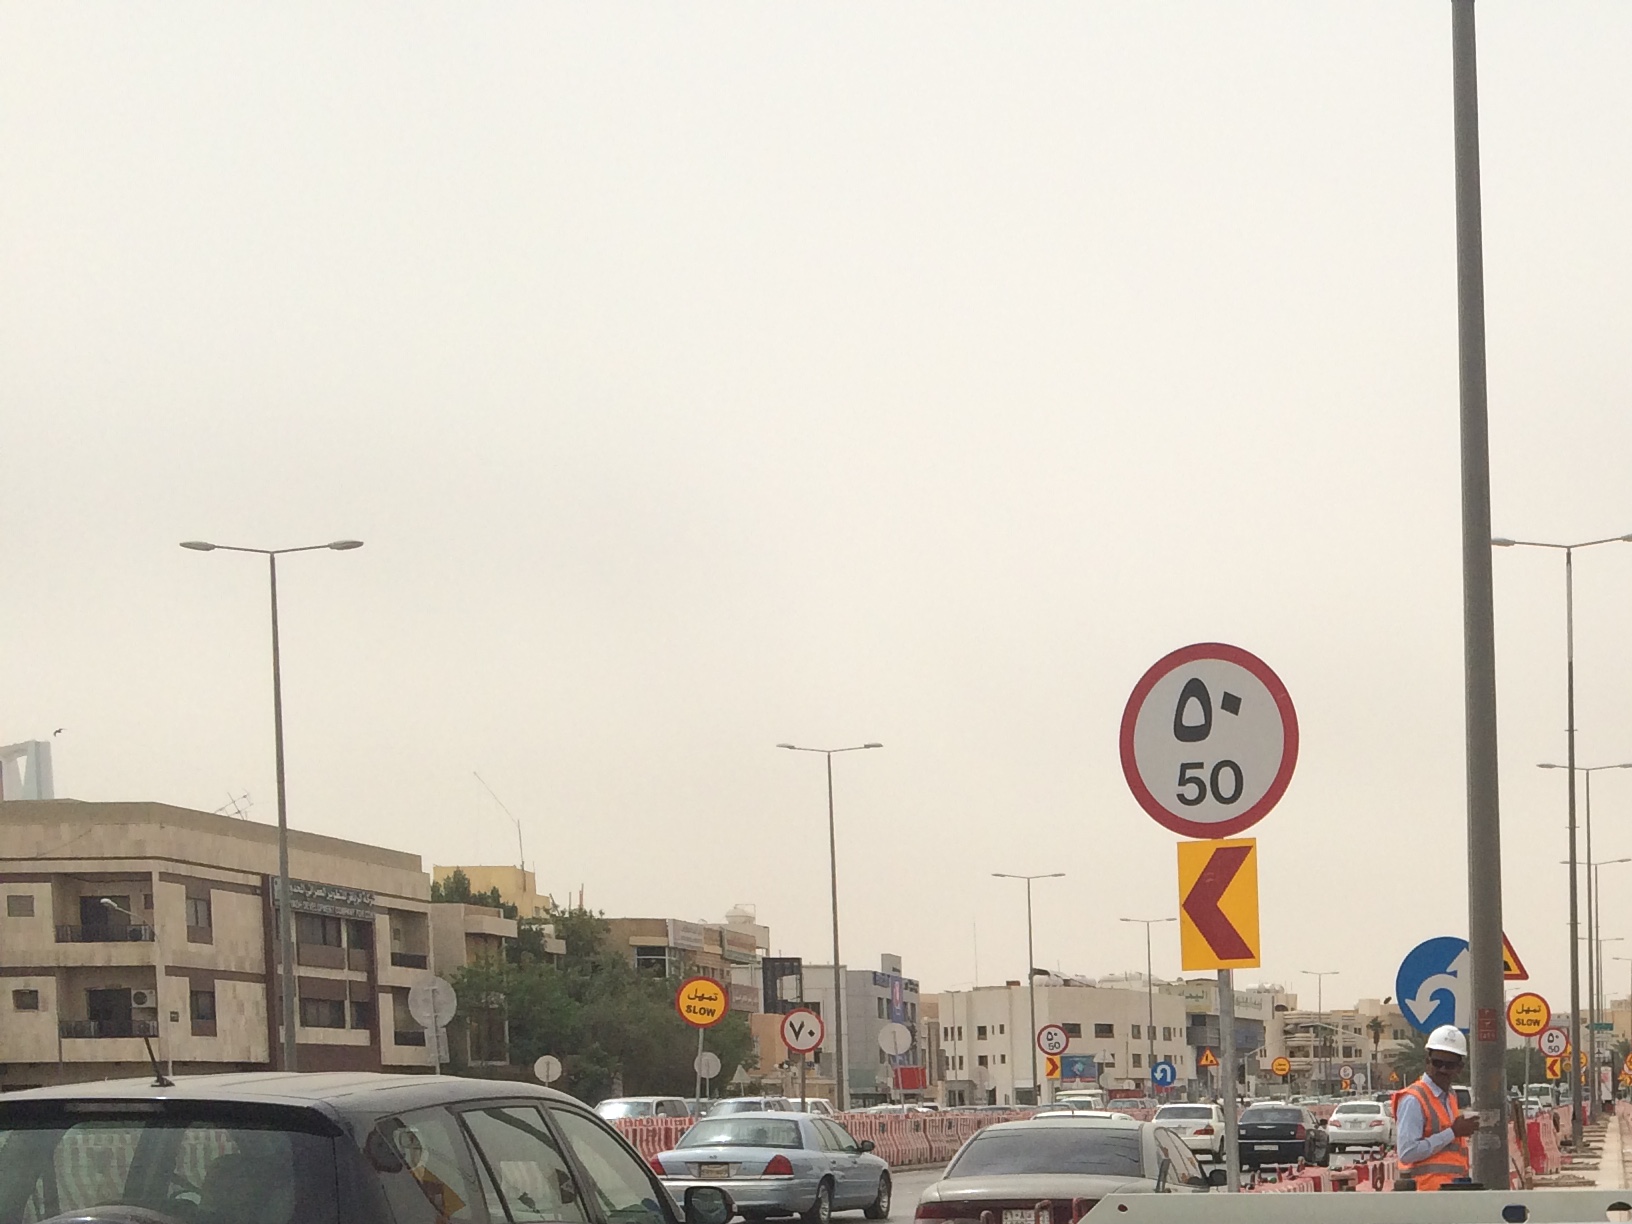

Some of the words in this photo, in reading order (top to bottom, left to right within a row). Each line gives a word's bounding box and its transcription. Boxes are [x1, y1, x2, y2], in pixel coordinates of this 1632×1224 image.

[1174, 677, 1242, 742] ٥٠
[1176, 759, 1244, 806] 50
[688, 988, 718, 1001] تمهل
[685, 1005, 716, 1018] SLOW
[1516, 1004, 1541, 1014] تمهل
[1515, 1018, 1541, 1026] SLOW
[789, 1020, 815, 1041] ٧٠
[1048, 1041, 1060, 1050] 50
[1548, 1045, 1560, 1053] 50
